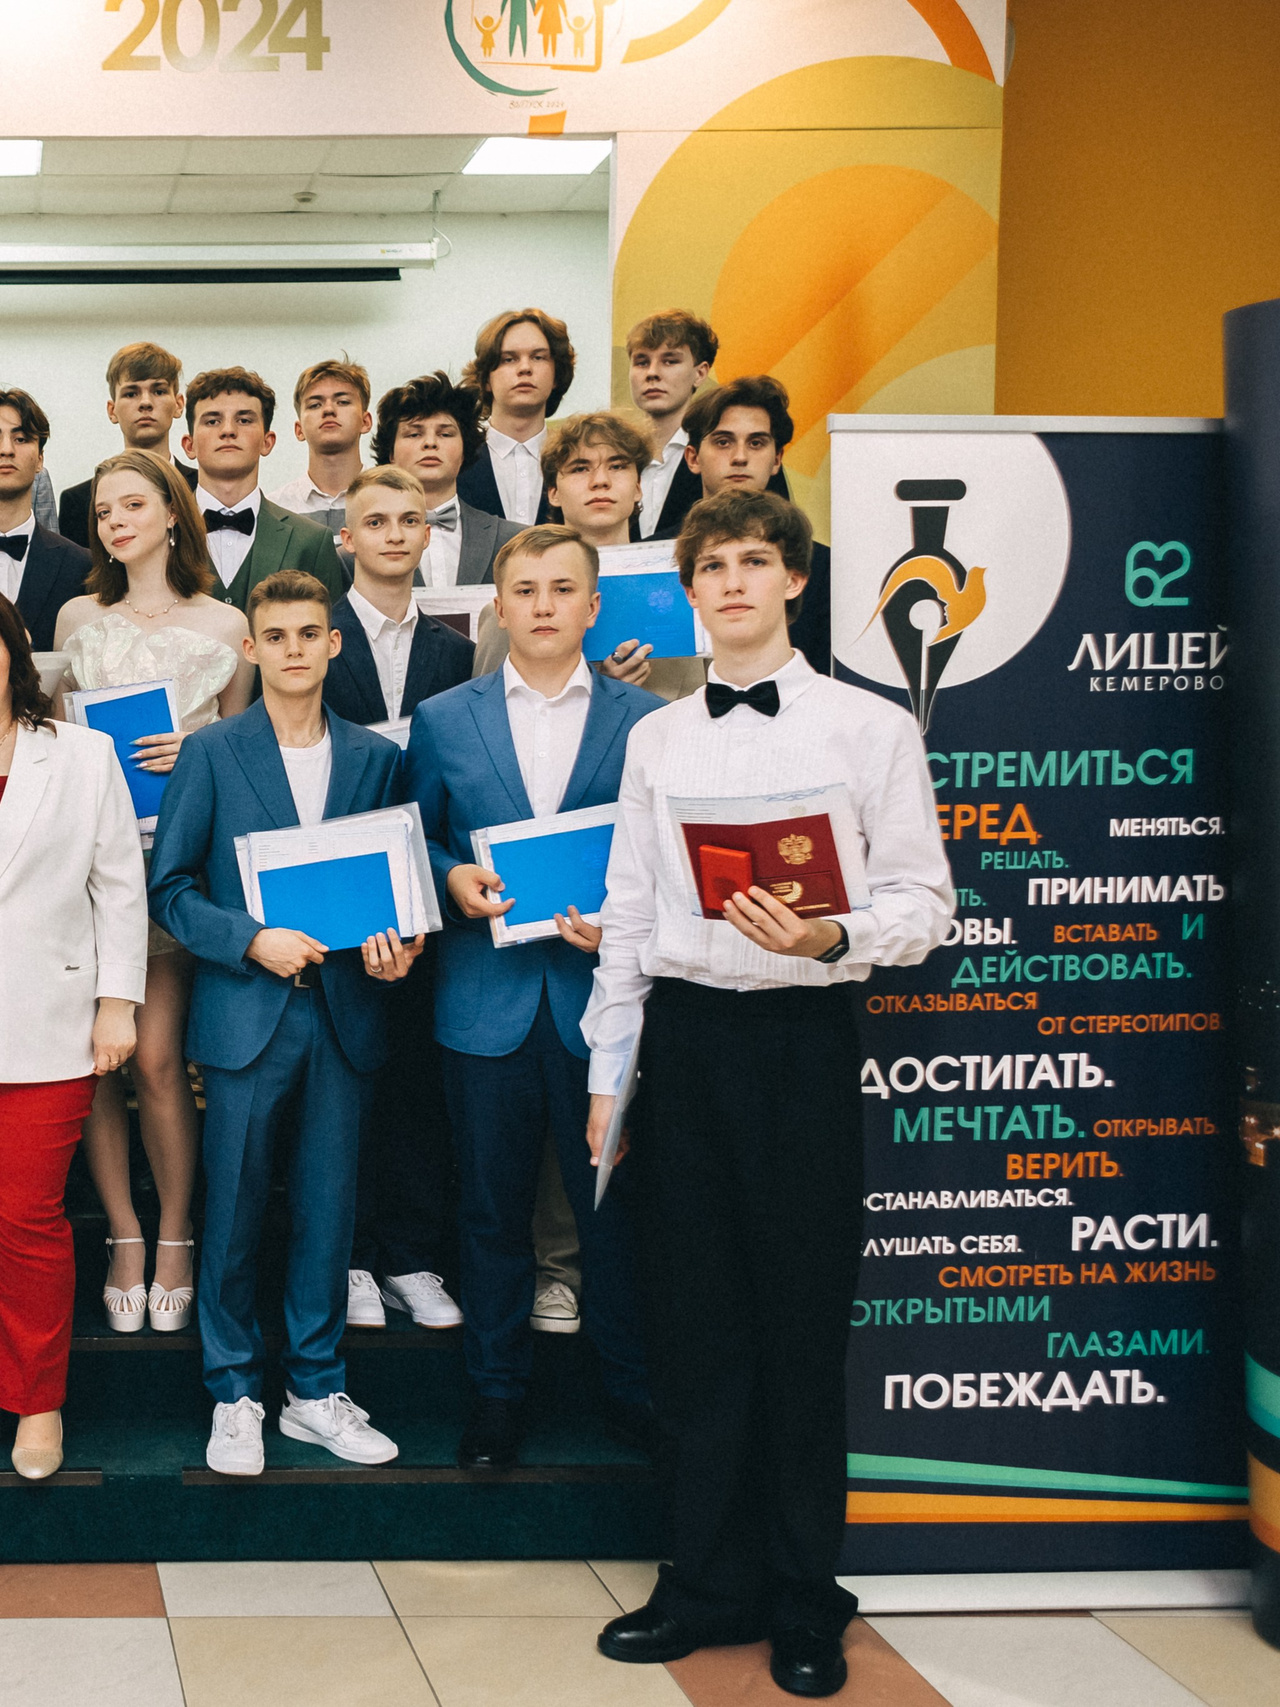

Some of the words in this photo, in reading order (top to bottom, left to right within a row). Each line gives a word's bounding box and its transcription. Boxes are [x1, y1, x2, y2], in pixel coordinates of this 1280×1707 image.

[102, 0, 330, 72] 2024
[1090, 676, 1224, 691] КЕМЕРОВО
[926, 749, 1194, 790] СТРЕМИТЬСЯ
[1110, 817, 1226, 837] МЕНЯТЬСЯ.
[981, 851, 1069, 869] РЕШАТЬ.
[1028, 875, 1223, 905] ПРИНИМАТЬ
[1054, 923, 1157, 943] ВСТАВАТЬ
[1182, 914, 1203, 940] И
[952, 950, 1191, 988] ДЕЙСТВОВАТЬ.
[868, 992, 1037, 1013] ОТКАЗЫВАТЬСЯ
[1038, 1017, 1066, 1035] ОТ
[861, 1053, 1114, 1099] ДОСТИГАТЬ.
[894, 1105, 1084, 1142] МЕЧТАТЬ.
[864, 1188, 1073, 1211] СТАНАВЛИВАТЬСЯ.
[861, 1236, 956, 1256] ЛУШАТЬ
[960, 1235, 1022, 1254] СЕБЯ.
[1072, 1214, 1219, 1251] РАСТИ.
[939, 1264, 1073, 1288] СМОТРЕТЬ
[1081, 1263, 1117, 1283] НА
[1125, 1261, 1217, 1283] ЖИЗНЬ
[851, 1296, 1049, 1326] ОТКРЫТЫМИ
[885, 1370, 1165, 1412] ПОБЕЖДАТЬ.
